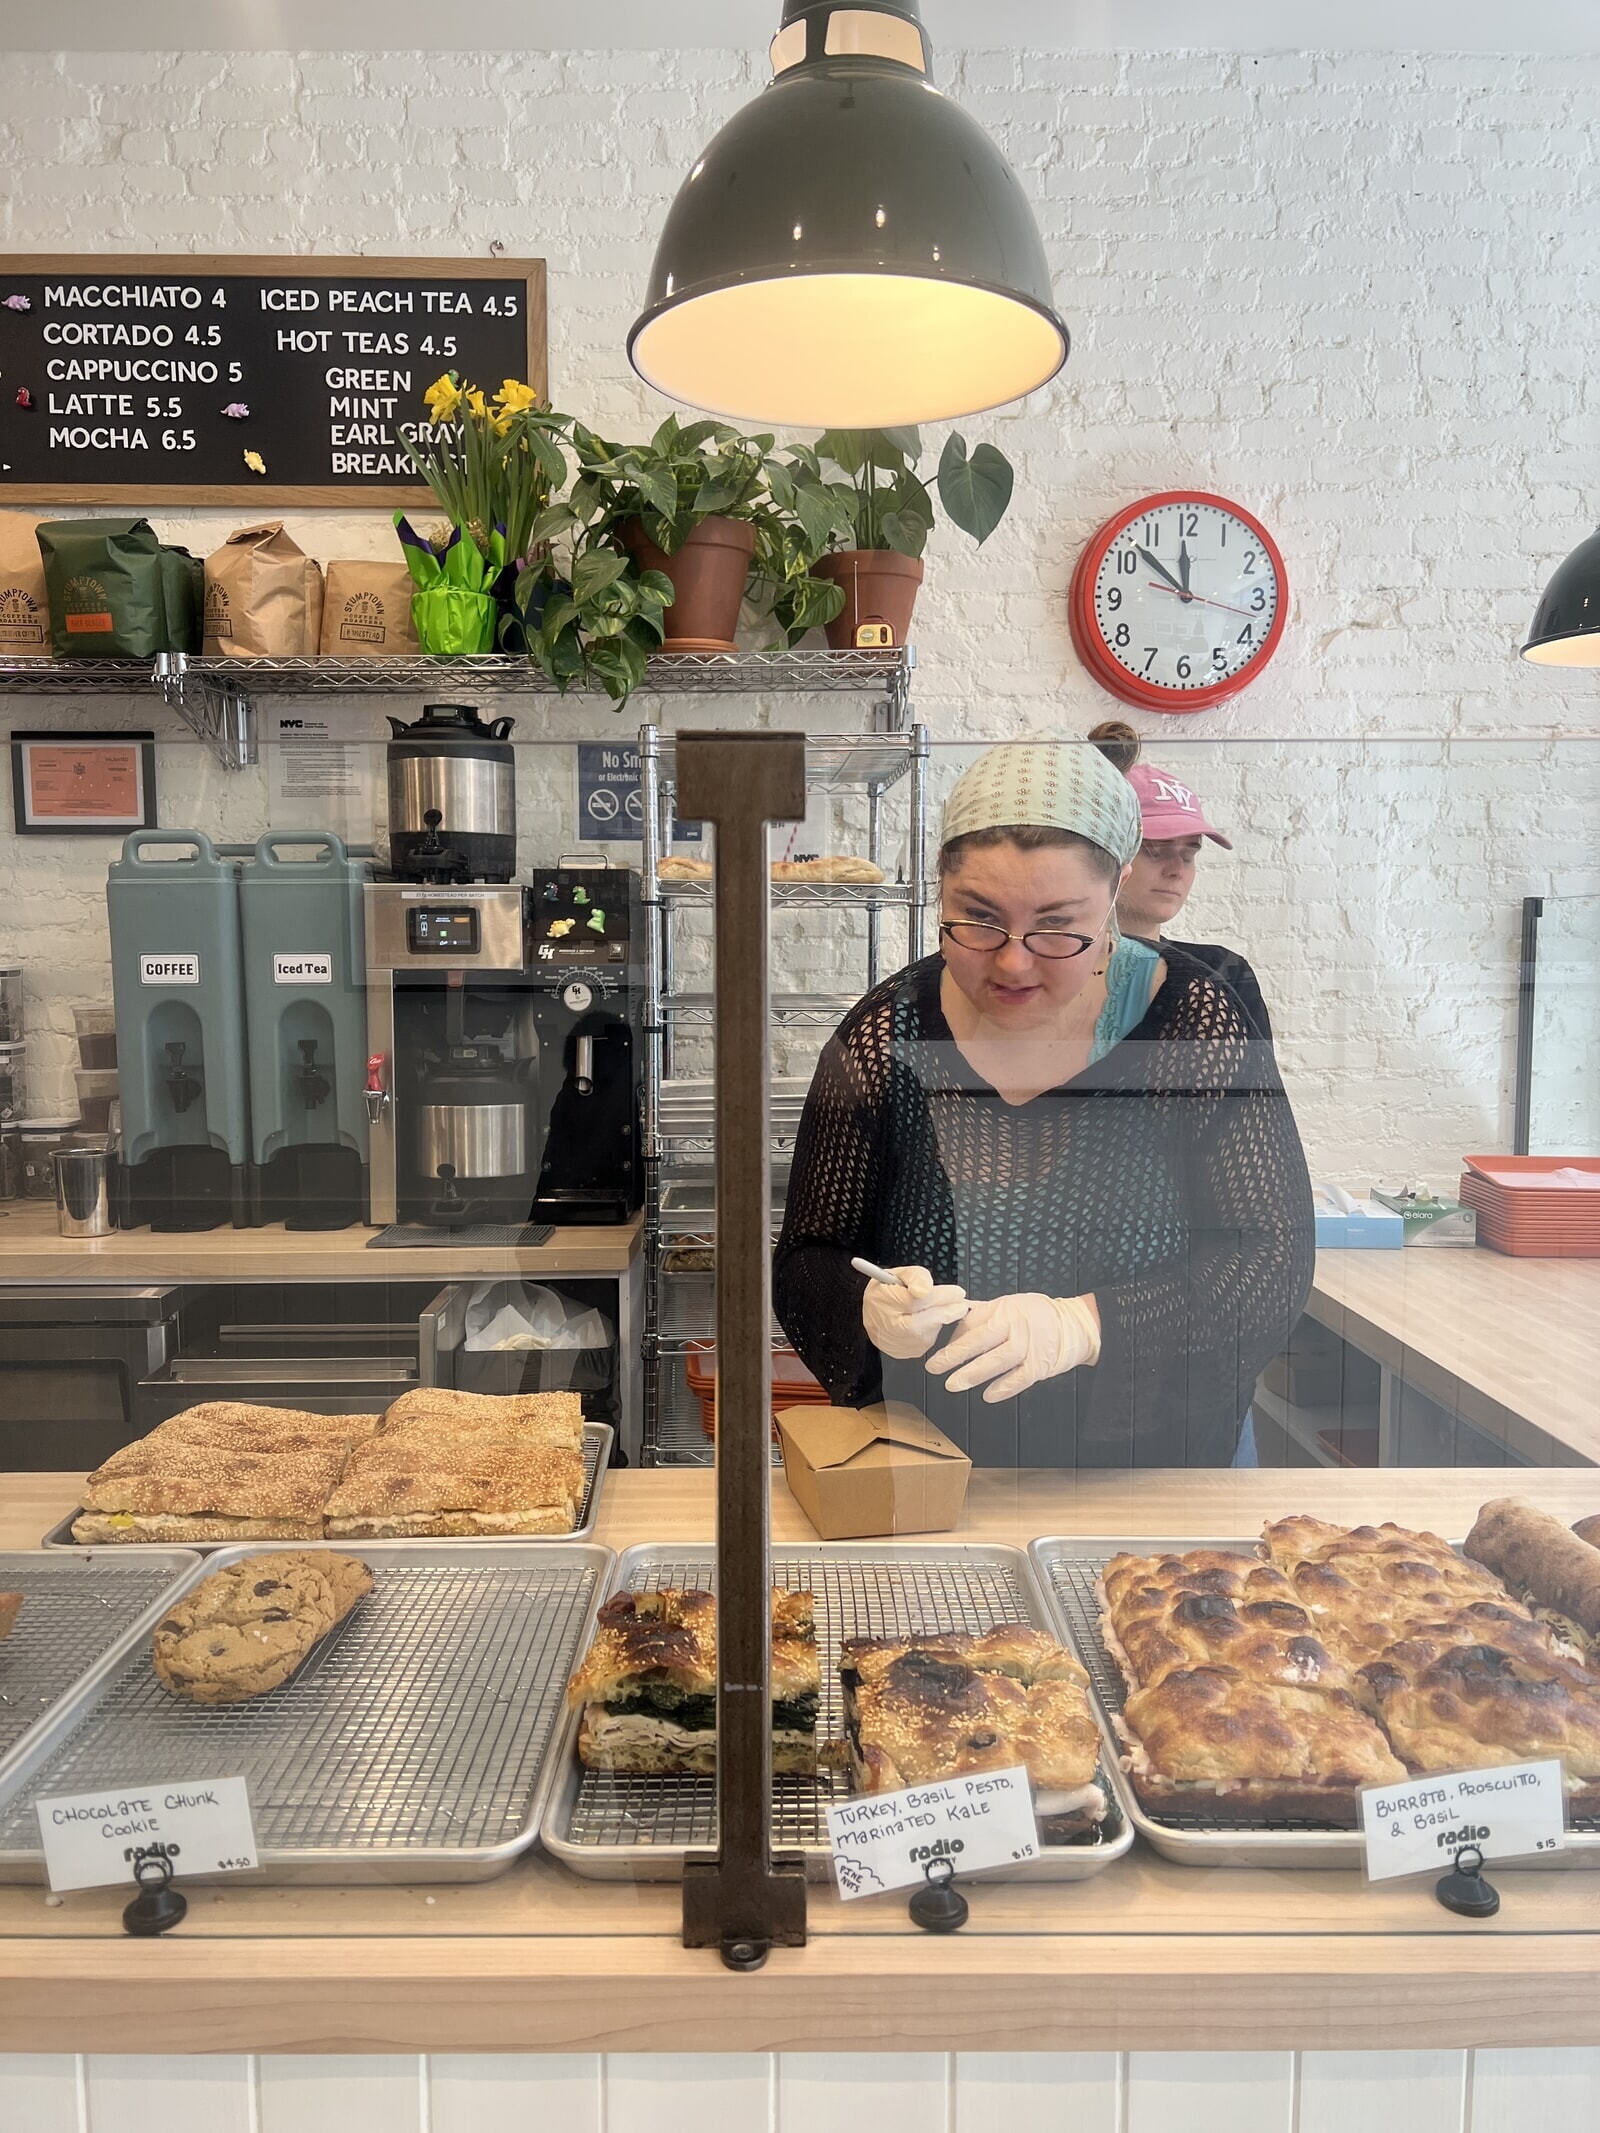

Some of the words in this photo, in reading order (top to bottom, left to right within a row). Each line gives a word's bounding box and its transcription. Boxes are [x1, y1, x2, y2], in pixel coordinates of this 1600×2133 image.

[44, 285, 202, 309] MACCHIATO
[211, 288, 227, 308] 4
[260, 289, 320, 312] ICED
[328, 290, 414, 313] PEACH
[421, 291, 473, 314] TEA
[482, 296, 518, 317] 4.5
[43, 323, 174, 347] CORTADO
[184, 325, 222, 346] 4.5
[276, 329, 333, 353] HOT
[342, 331, 409, 355] TEAS
[420, 335, 457, 357] 4.5
[46, 358, 219, 383] CAPPUCCINO
[228, 362, 243, 383] 5
[325, 367, 412, 392] GREEN
[48, 393, 135, 416] LATTE
[146, 397, 182, 418] 5.5
[330, 396, 398, 419] MINT
[50, 427, 149, 450] MOCHA
[162, 429, 197, 450] 6.5
[331, 423, 395, 446] EARL
[400, 422, 465, 445] GRAY
[1145, 523, 1159, 547] 11
[1179, 512, 1198, 537] 12
[1221, 523, 1226, 547] 1
[1117, 550, 1137, 575] 10
[1243, 551, 1256, 575] 2
[64, 576, 108, 602] STUMPTOWN
[1107, 587, 1122, 611] 9
[1250, 587, 1266, 611] 3
[344, 592, 385, 615] STUMPTOWN
[1115, 623, 1130, 647] 8
[1236, 623, 1253, 645] 4
[1143, 647, 1158, 671] 7
[1176, 655, 1191, 679] 6
[1212, 647, 1228, 671] 5
[280, 720, 303, 728] NYC
[602, 751, 620, 768] No
[607, 773, 639, 781] Electronic
[1151, 778, 1198, 812] NY
[146, 963, 194, 976] COFFEE
[278, 963, 303, 974] Iced
[304, 963, 328, 974] Tea
[1390, 1822, 1406, 1837] &
[1437, 1825, 1491, 1848] radio
[123, 1842, 181, 1863] radio
[909, 1838, 965, 1864] radio
[839, 1864, 863, 1884] PINE
[840, 1875, 860, 1893] NUTS
